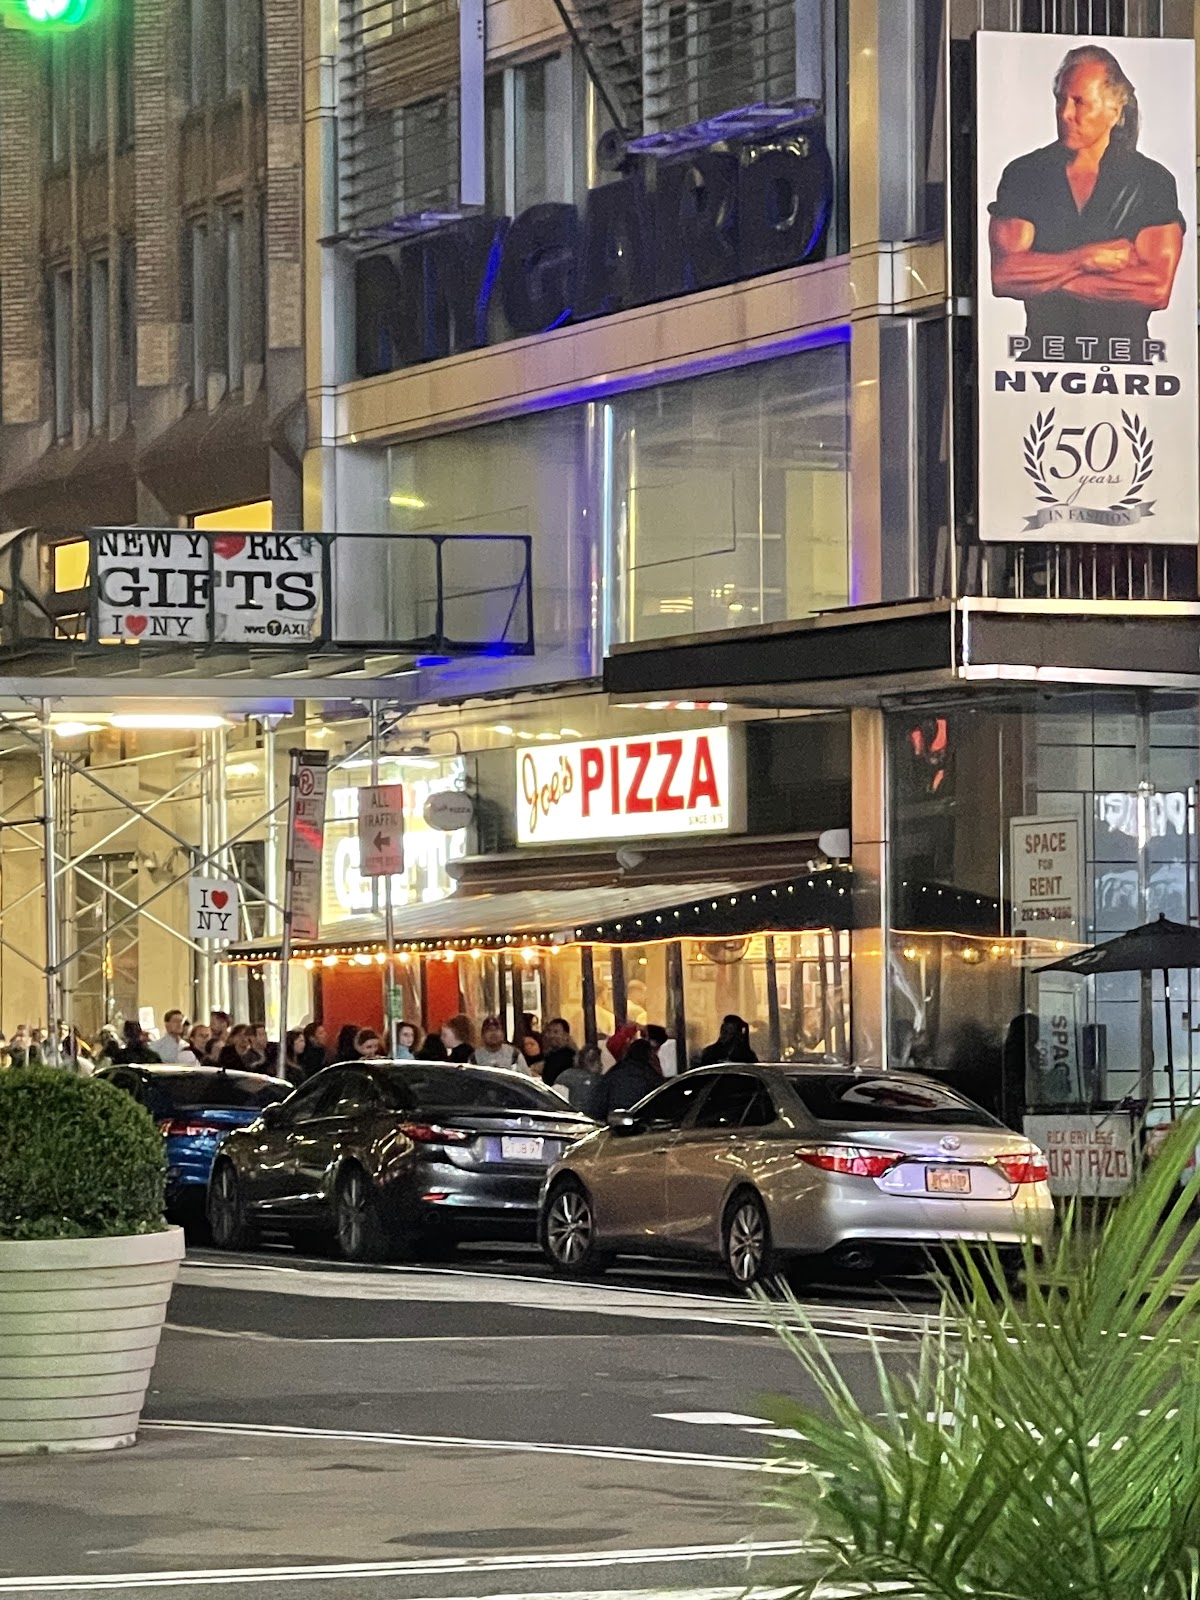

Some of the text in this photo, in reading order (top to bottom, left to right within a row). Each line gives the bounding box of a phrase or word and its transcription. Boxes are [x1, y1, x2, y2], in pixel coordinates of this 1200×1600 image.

[1007, 334, 1167, 363] PETER
[995, 365, 1181, 396] NYGÅRD
[1049, 421, 1119, 480] 50
[1063, 472, 1123, 506] years
[1049, 509, 1131, 523] IN FASHION
[99, 533, 172, 558] NEW
[98, 566, 317, 611] GIFTS
[151, 615, 193, 636] NY
[521, 736, 720, 834] Joe's PIZZA
[372, 792, 389, 808] ALL
[1025, 832, 1066, 854] SPACE
[1038, 859, 1053, 870] FOR
[1029, 876, 1062, 897] RENT
[200, 889, 209, 908] I
[197, 911, 232, 931] NY
